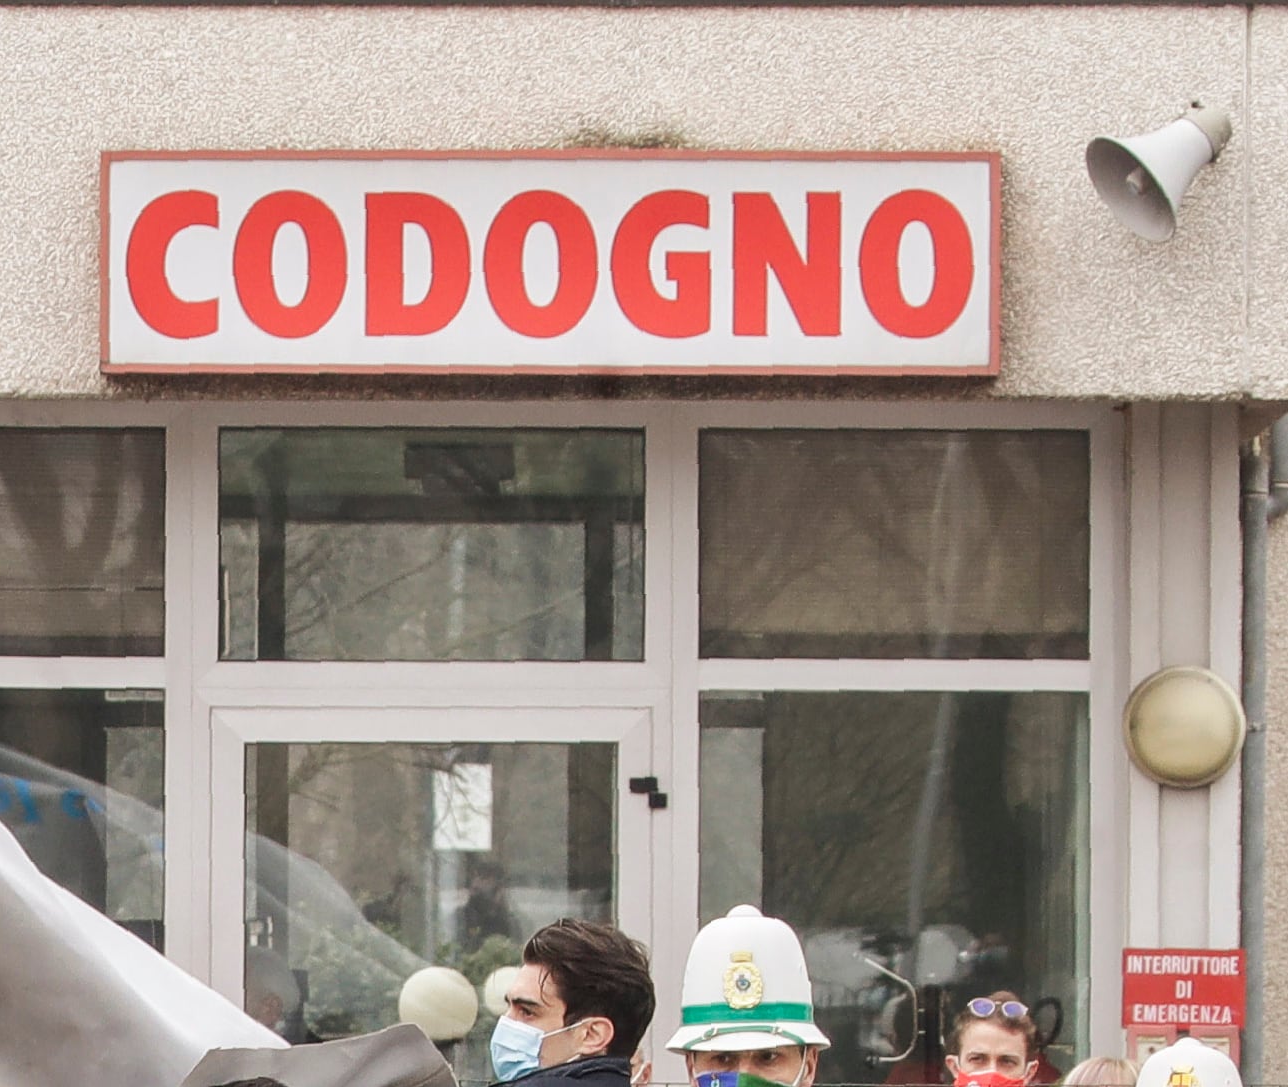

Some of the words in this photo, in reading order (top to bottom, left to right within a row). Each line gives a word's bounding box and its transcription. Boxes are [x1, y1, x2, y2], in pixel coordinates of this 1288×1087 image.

[125, 188, 975, 340] CODOGNO
[1126, 955, 1240, 976] INTERRUTTORE
[1175, 980, 1193, 999] DI
[1132, 1003, 1233, 1024] EMERGENZA
